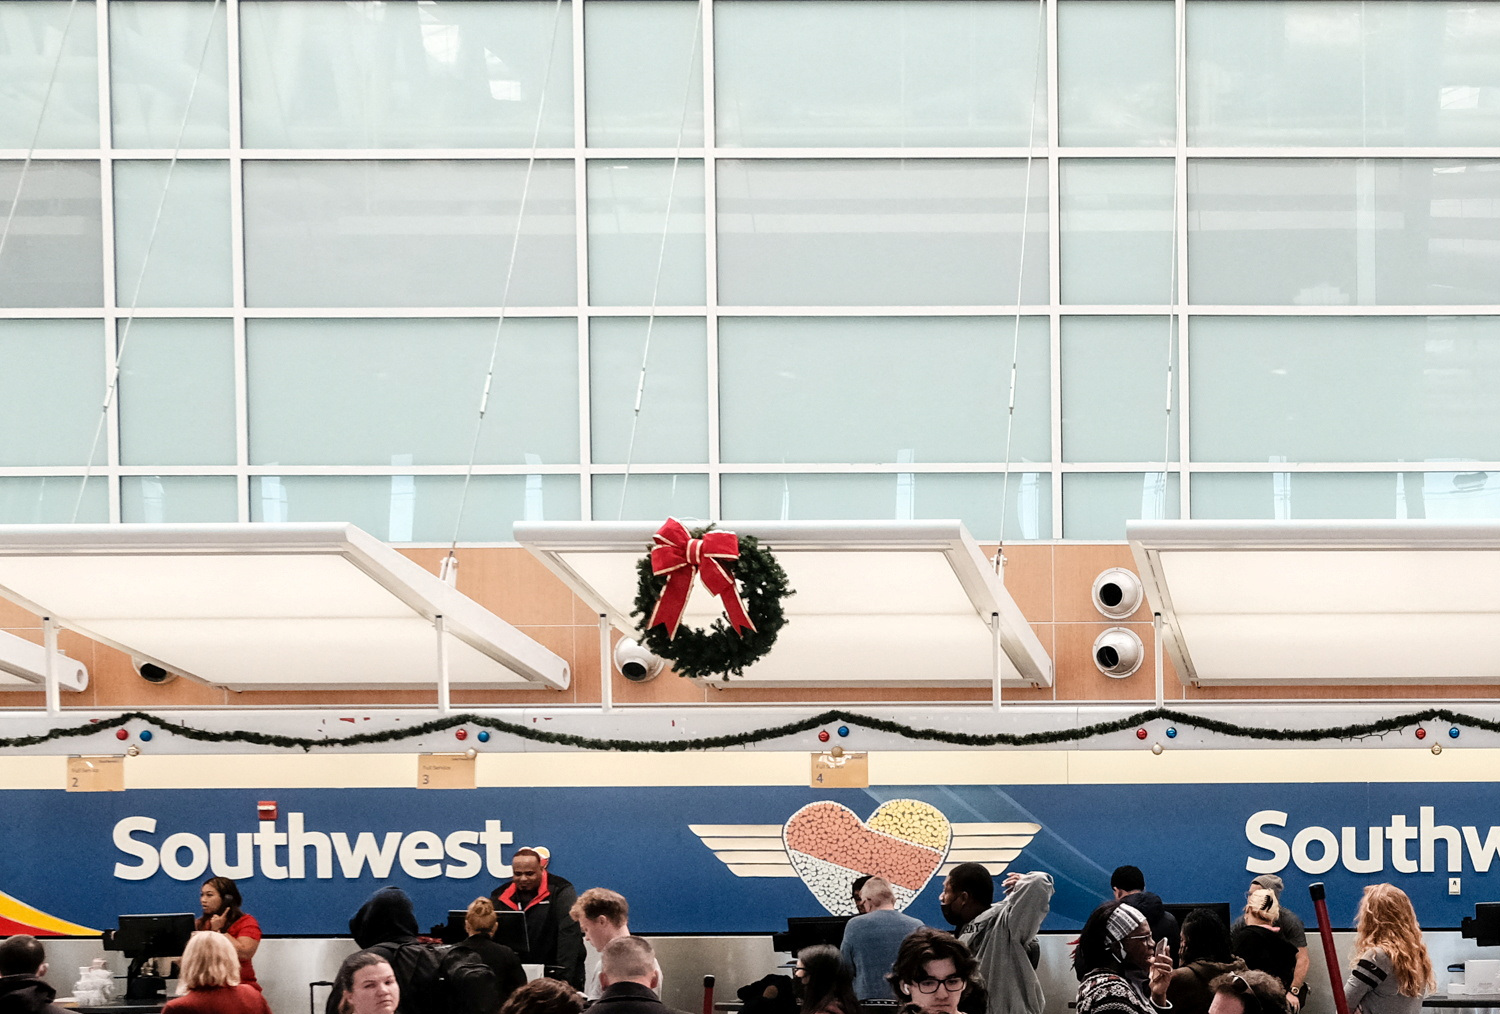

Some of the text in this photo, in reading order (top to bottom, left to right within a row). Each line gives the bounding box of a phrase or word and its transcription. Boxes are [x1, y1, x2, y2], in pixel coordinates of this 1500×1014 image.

[72, 777, 79, 788] 2
[422, 774, 430, 785] 3
[816, 773, 824, 784] 4
[112, 812, 514, 881] Southwest
